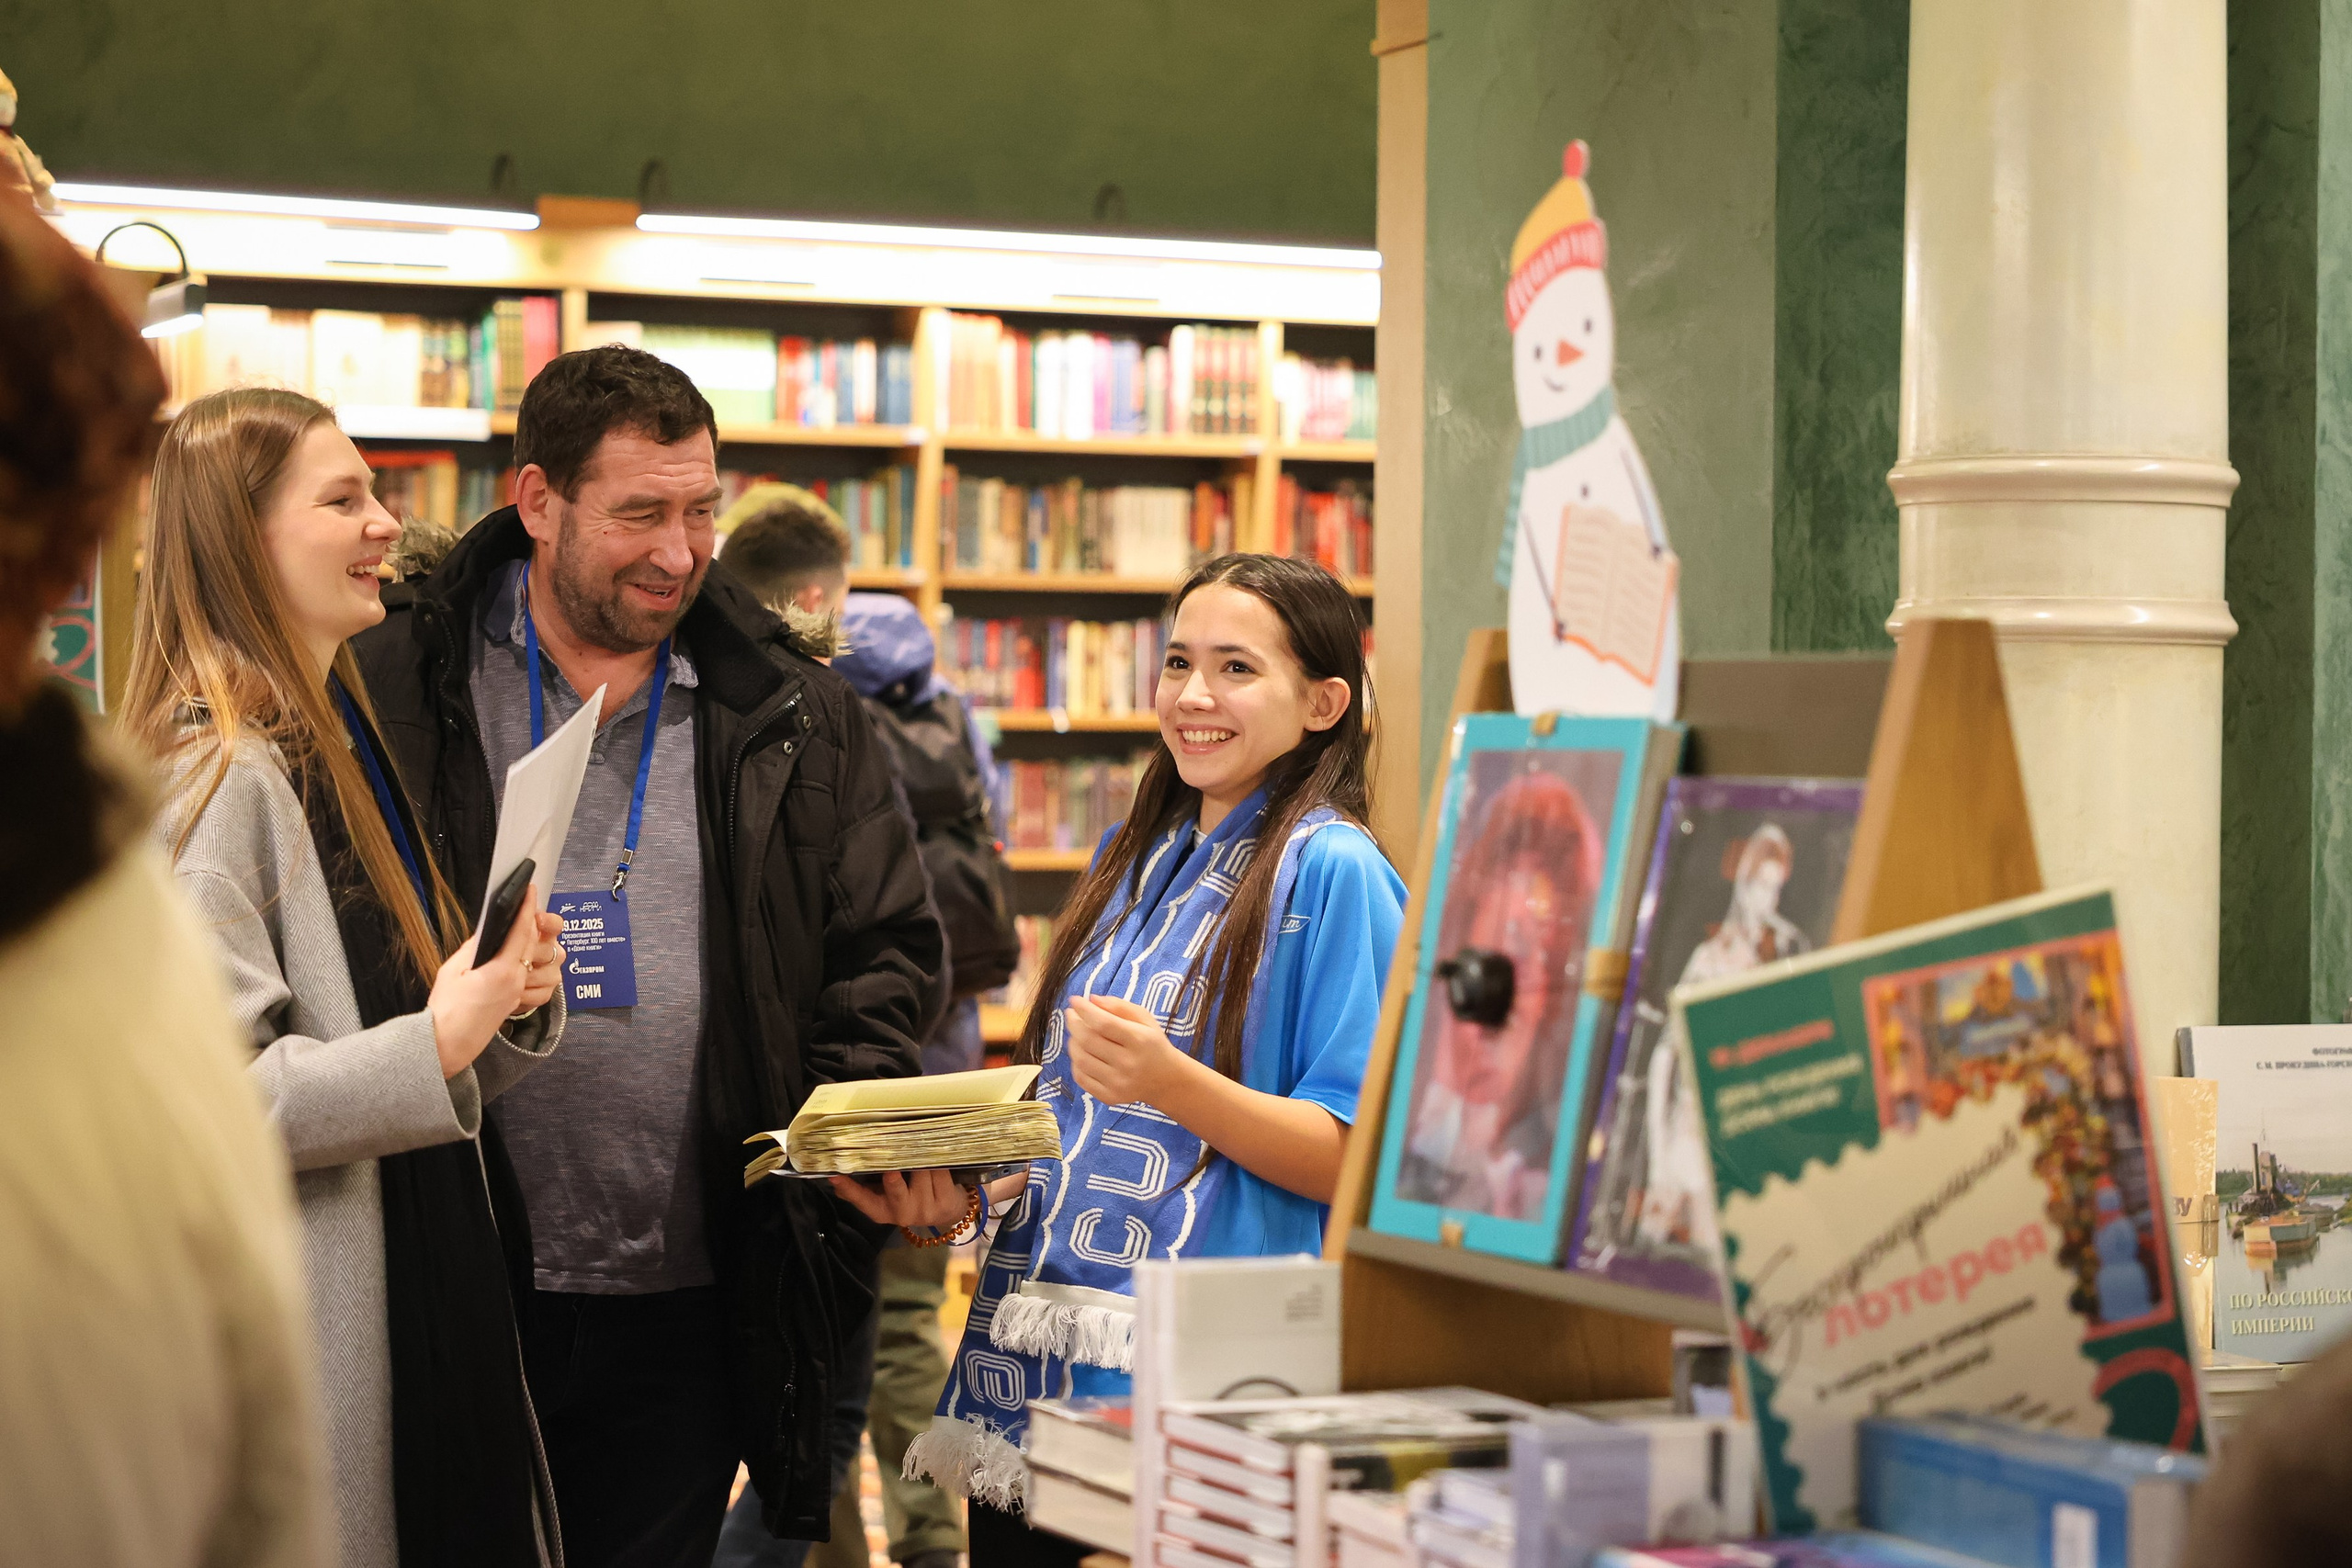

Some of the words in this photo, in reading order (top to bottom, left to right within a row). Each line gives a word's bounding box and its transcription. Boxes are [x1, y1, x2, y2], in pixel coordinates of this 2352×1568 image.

[562, 918, 604, 931] 9.12.2025
[576, 984, 602, 999] СМИ
[1823, 1222, 2050, 1349] лотерея
[2230, 1292, 2254, 1310] ПО
[2232, 1316, 2314, 1336] ИМПЕРИИ
